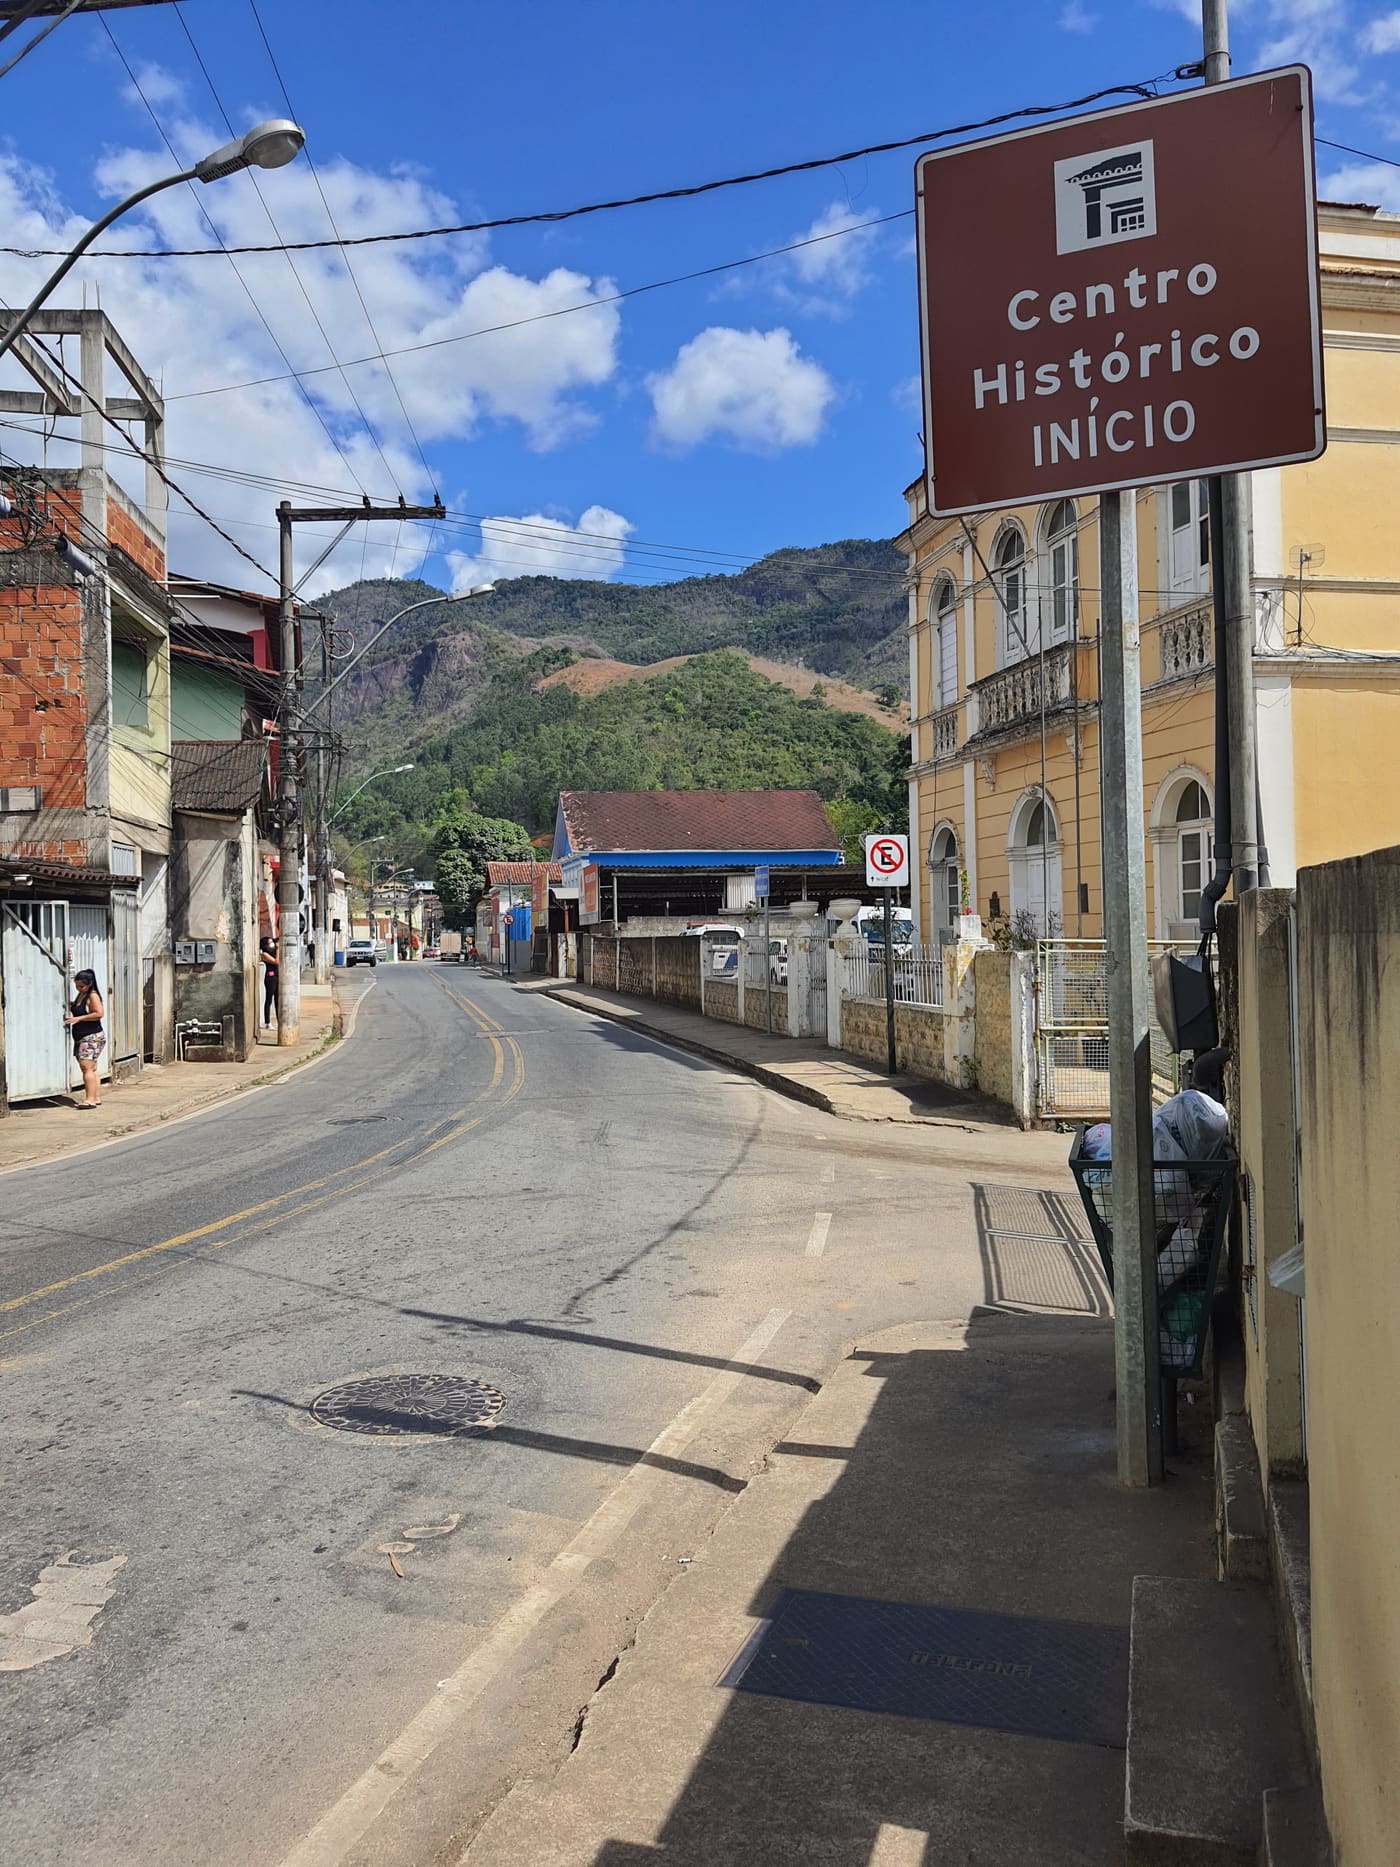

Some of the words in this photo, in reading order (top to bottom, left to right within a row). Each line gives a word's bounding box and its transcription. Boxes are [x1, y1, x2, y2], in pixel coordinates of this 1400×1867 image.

[1007, 262, 1217, 331] Centro
[973, 326, 1260, 409] Histórico
[1033, 396, 1196, 467] INÍCIO
[881, 846, 893, 865] E
